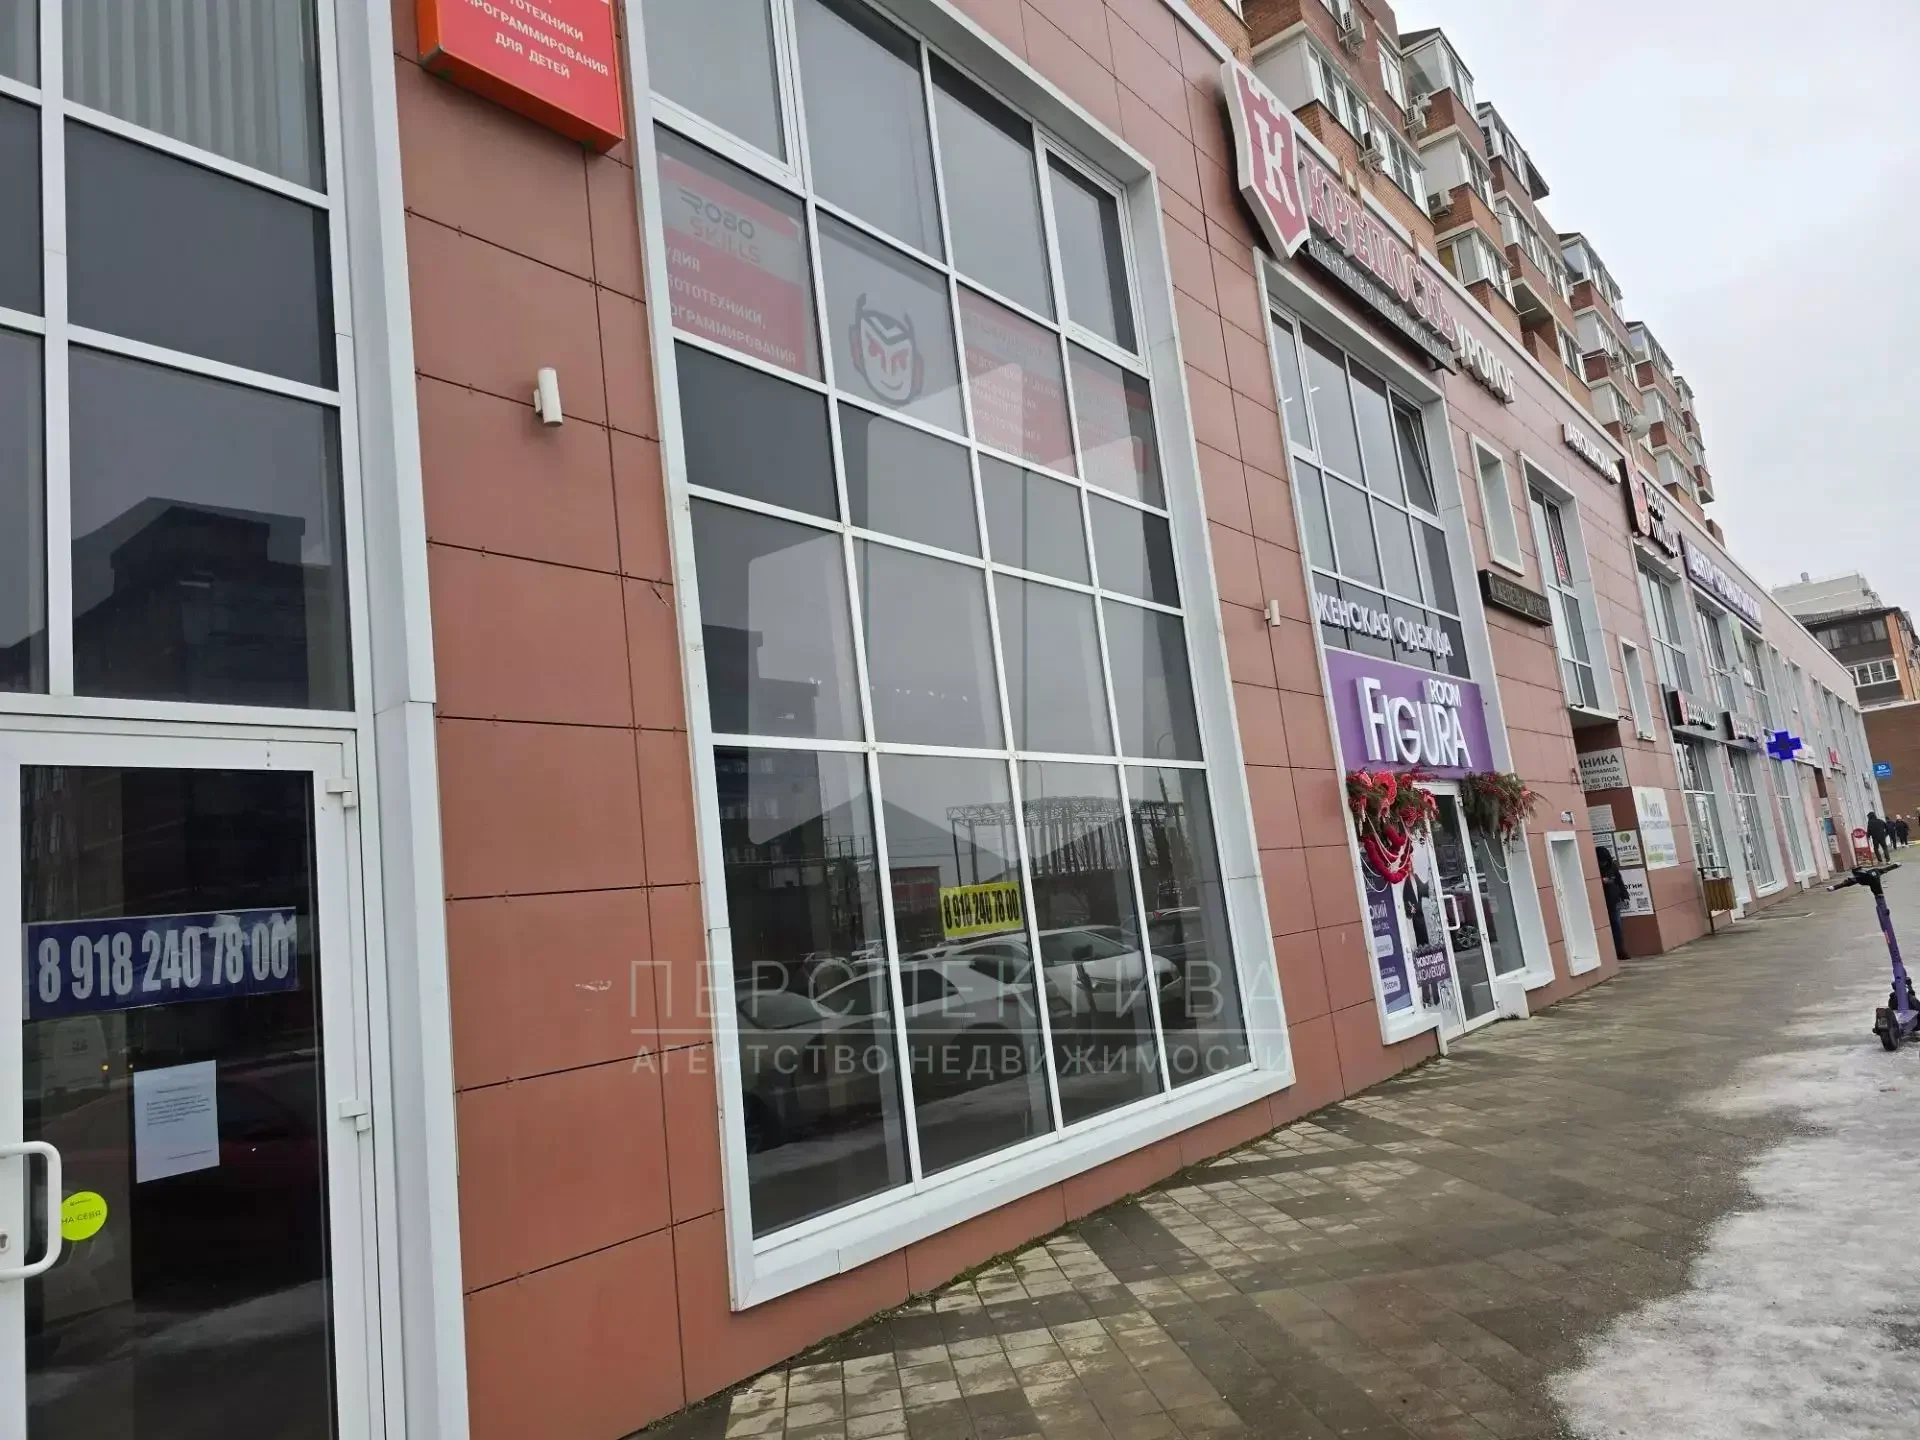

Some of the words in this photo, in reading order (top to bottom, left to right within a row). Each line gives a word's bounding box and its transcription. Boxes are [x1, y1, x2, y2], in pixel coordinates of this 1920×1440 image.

[508, 0, 584, 42] ОТЕХНИКИ
[495, 31, 524, 56] ДЛЯ
[528, 49, 571, 79] ДЕТЕЙ
[1301, 150, 1456, 342] КРЕПОСТЬ
[1316, 591, 1392, 640] ЖЕНСКАЯ
[1393, 616, 1454, 657] ОДЕЖДА
[1426, 678, 1462, 707] ROOM
[1358, 676, 1473, 768] FIGURA
[943, 894, 953, 930] 8
[952, 891, 973, 929] 918
[992, 889, 1006, 923] 78
[38, 937, 62, 1003] 8
[70, 931, 133, 1000] 918
[141, 929, 201, 993] 240
[208, 922, 244, 985] 78
[251, 922, 290, 981] 00
